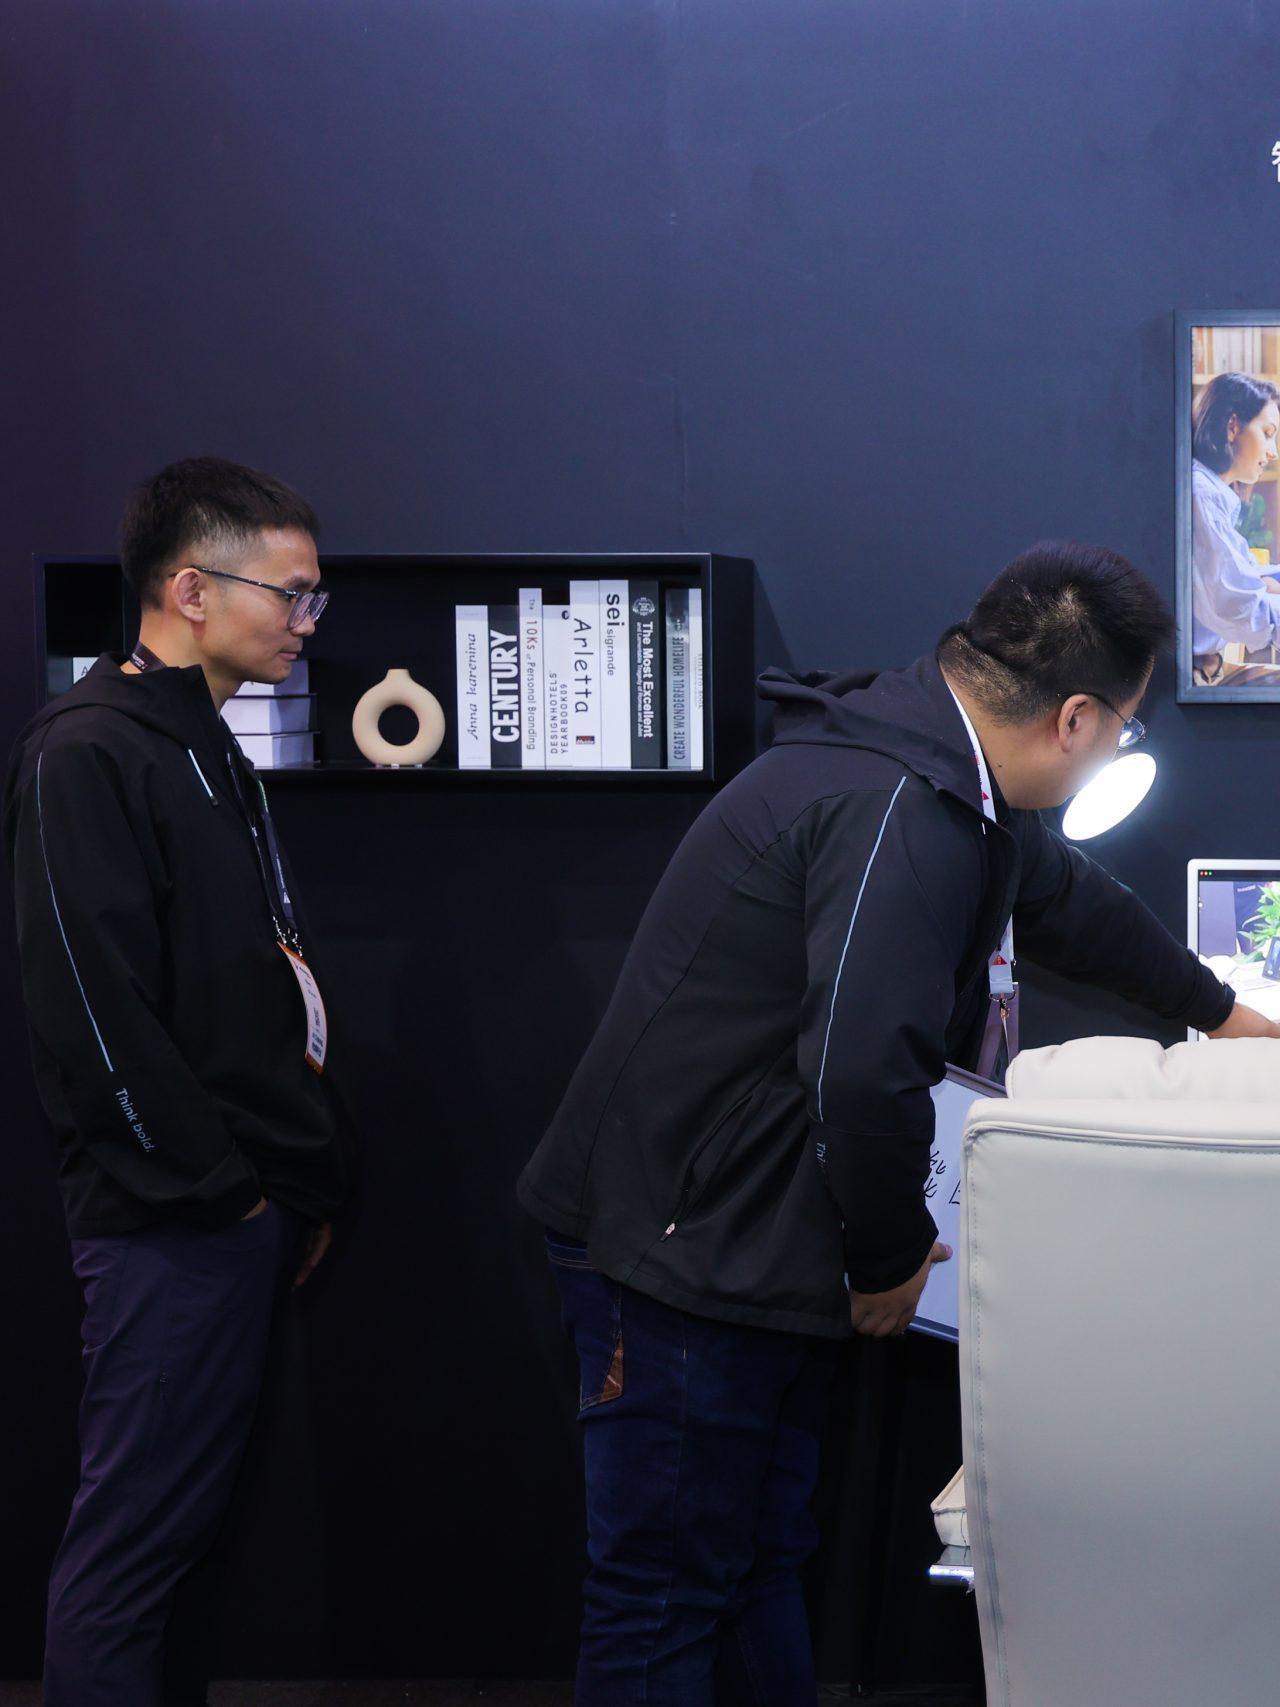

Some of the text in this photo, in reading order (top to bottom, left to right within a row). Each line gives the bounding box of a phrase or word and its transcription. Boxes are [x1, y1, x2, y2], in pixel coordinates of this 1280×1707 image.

[605, 593, 625, 677] sei sigrande
[642, 621, 653, 645] The
[672, 636, 685, 677] HOMELIFE
[490, 629, 521, 743] CENTURY
[526, 662, 536, 703] Personal
[573, 618, 593, 714] Arletta
[642, 647, 654, 678] Most
[642, 681, 654, 738] Excellent
[673, 678, 686, 729] WONDERFUL
[526, 706, 537, 750] Branding
[673, 731, 686, 760] CREATE
[115, 1087, 157, 1152] Think bold.
